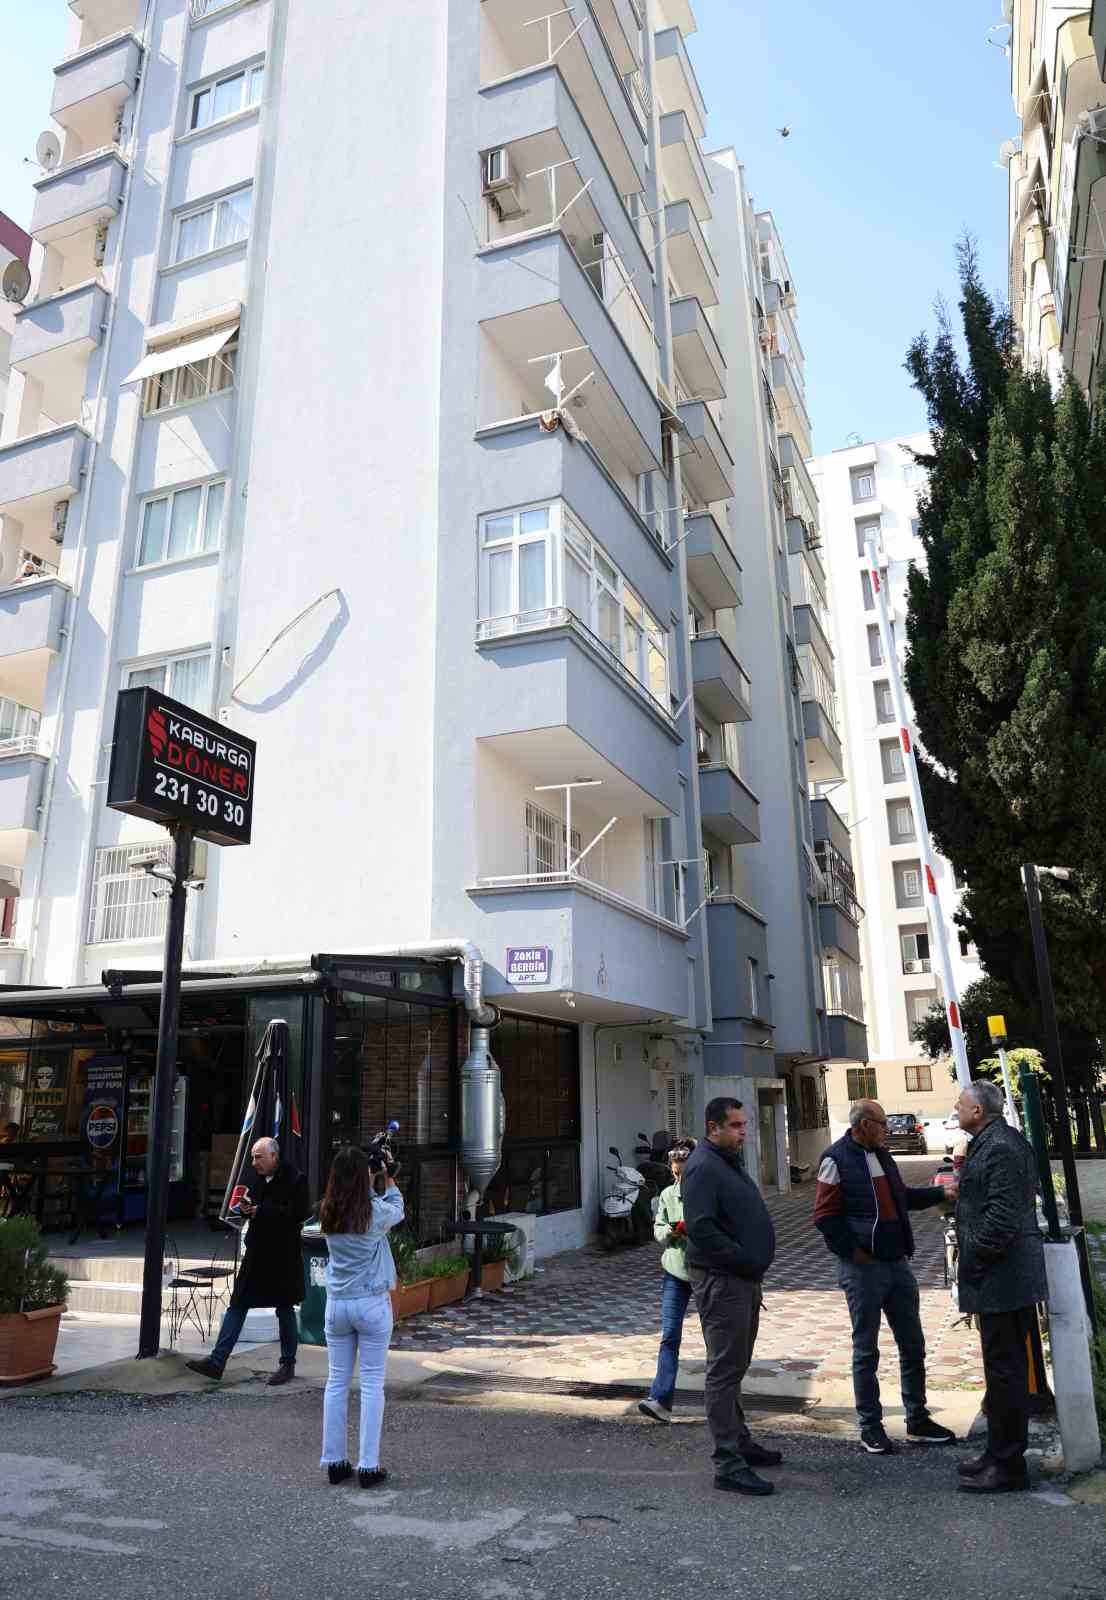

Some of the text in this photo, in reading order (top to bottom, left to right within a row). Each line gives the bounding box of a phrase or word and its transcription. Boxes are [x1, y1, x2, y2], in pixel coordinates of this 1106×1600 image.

[167, 742, 247, 794] DÖNER
[169, 720, 248, 770] KABURGA
[154, 772, 244, 826] 231 30 30
